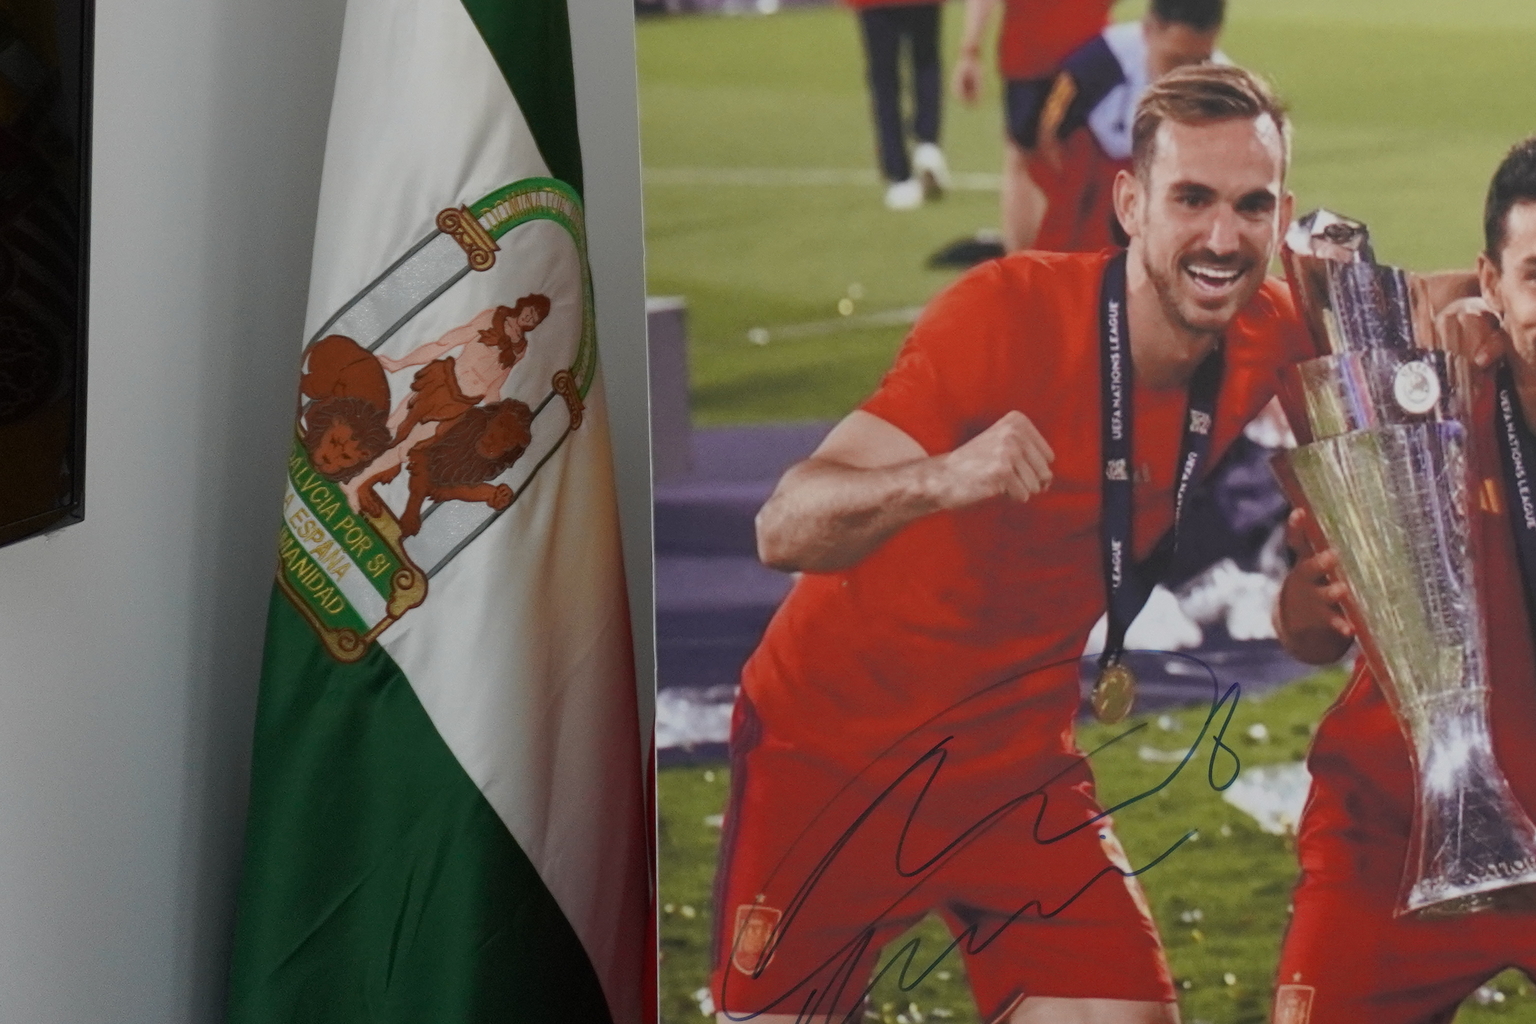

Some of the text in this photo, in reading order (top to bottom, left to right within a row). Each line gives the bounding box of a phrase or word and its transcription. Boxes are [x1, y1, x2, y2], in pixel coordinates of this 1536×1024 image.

[1108, 298, 1123, 440] UEFA NATIONS LEAGUE
[1500, 389, 1513, 422] UEFA
[1507, 422, 1527, 479] NATIONS
[333, 514, 374, 558] POR
[366, 553, 392, 579] SI
